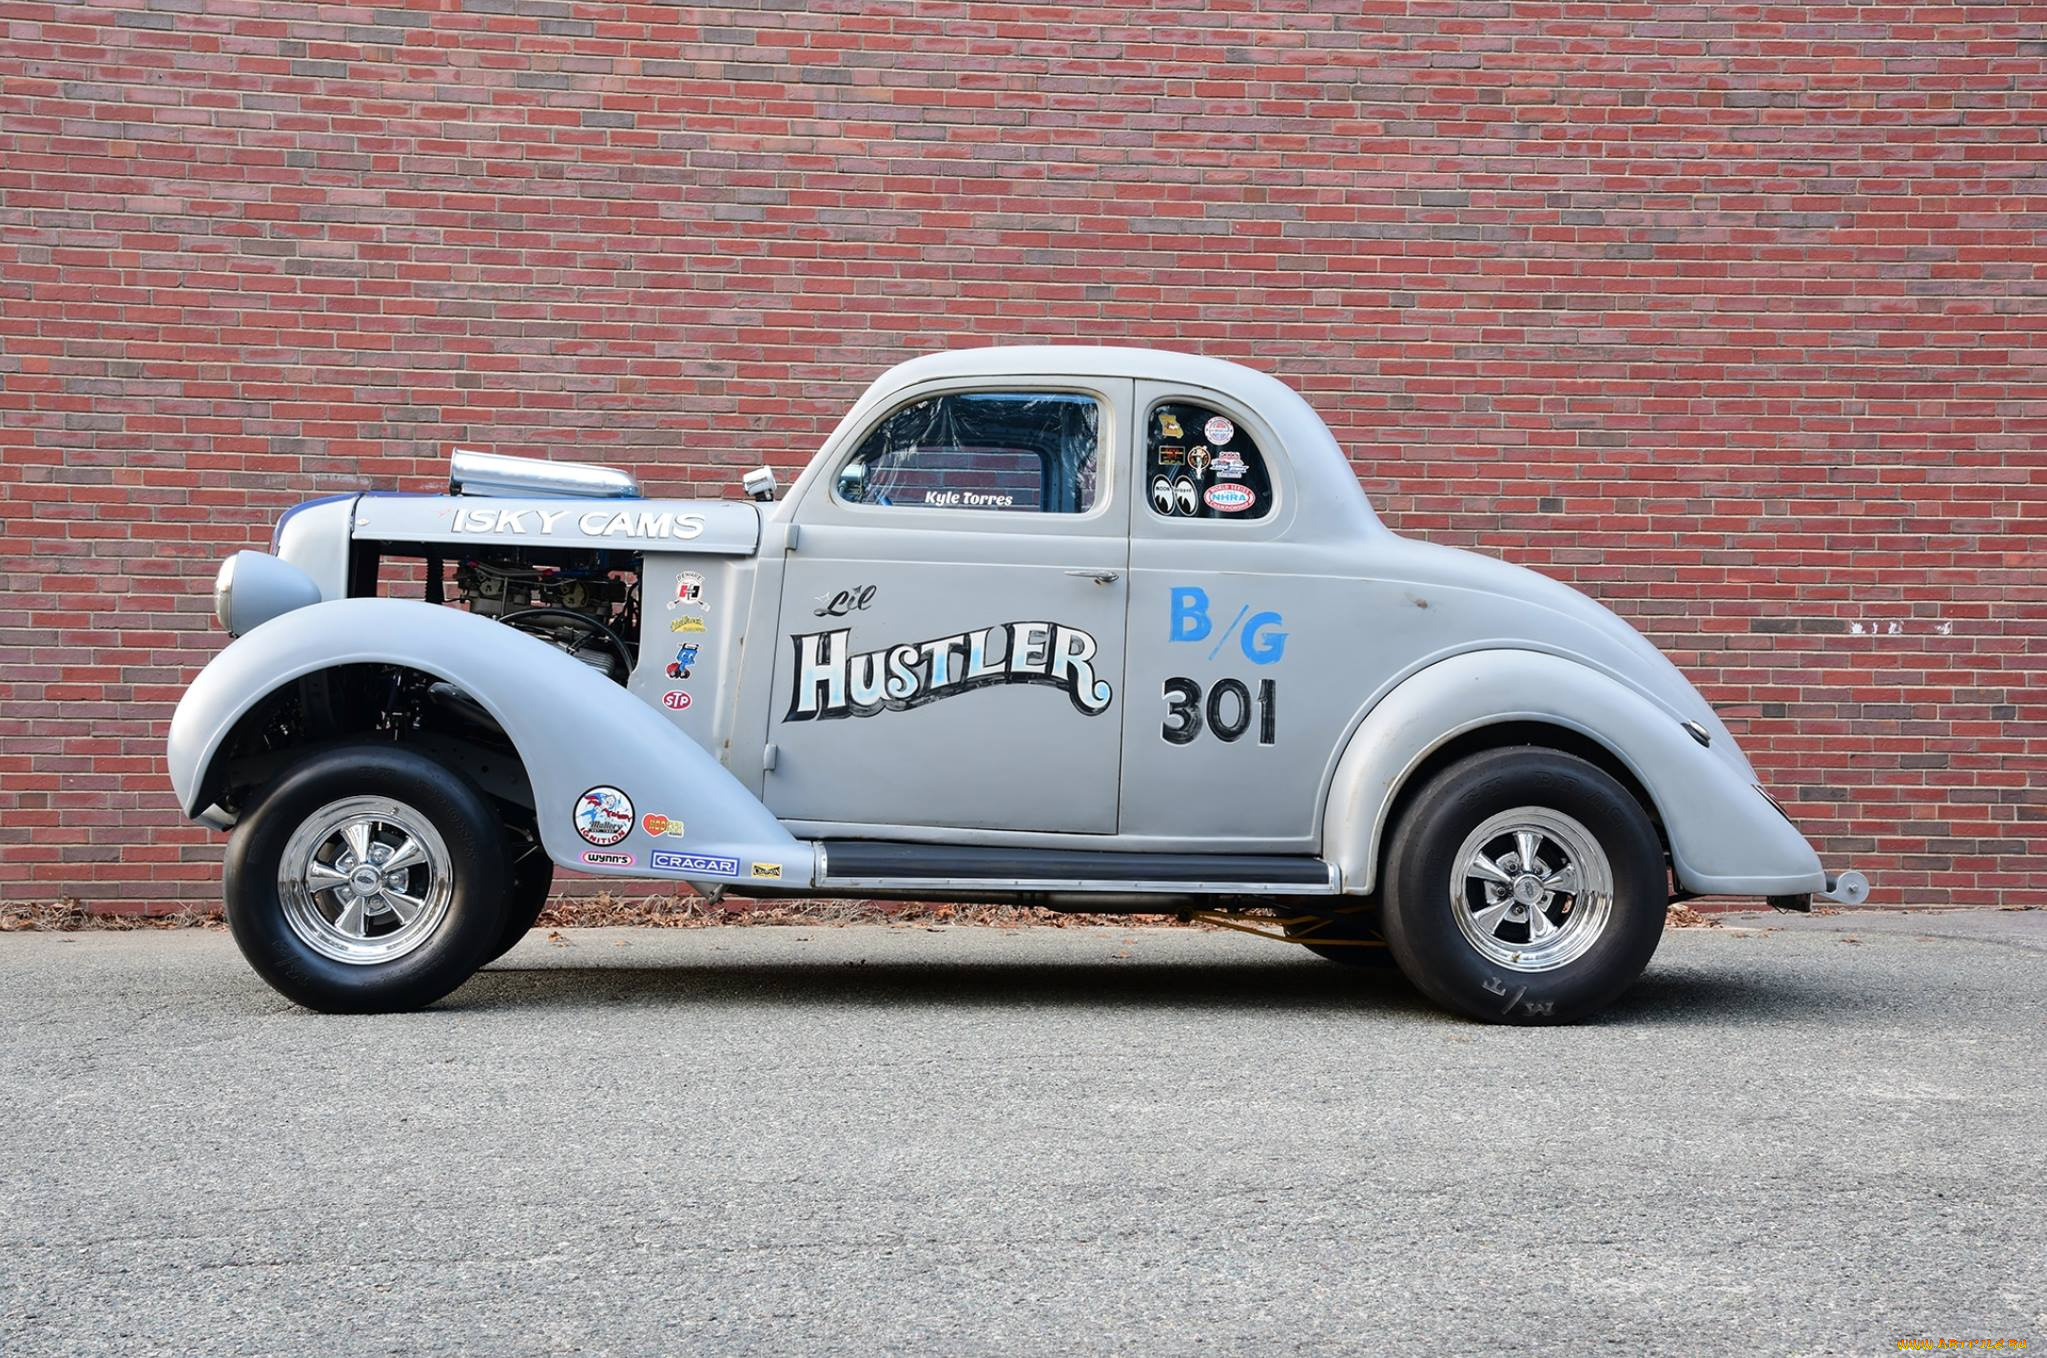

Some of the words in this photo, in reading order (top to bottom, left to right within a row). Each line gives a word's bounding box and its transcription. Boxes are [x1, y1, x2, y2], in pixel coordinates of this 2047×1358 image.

[925, 490, 960, 506] Kyle
[963, 491, 1013, 506] Torres
[451, 508, 573, 536] ISKY
[578, 511, 705, 540] CAMS
[1168, 585, 1290, 665] B/G
[781, 621, 1112, 724] HUSTLER
[665, 692, 689, 708] STP
[1160, 676, 1276, 747] 301
[580, 827, 625, 843] IGNITION
[656, 856, 733, 873] CRAGAR
